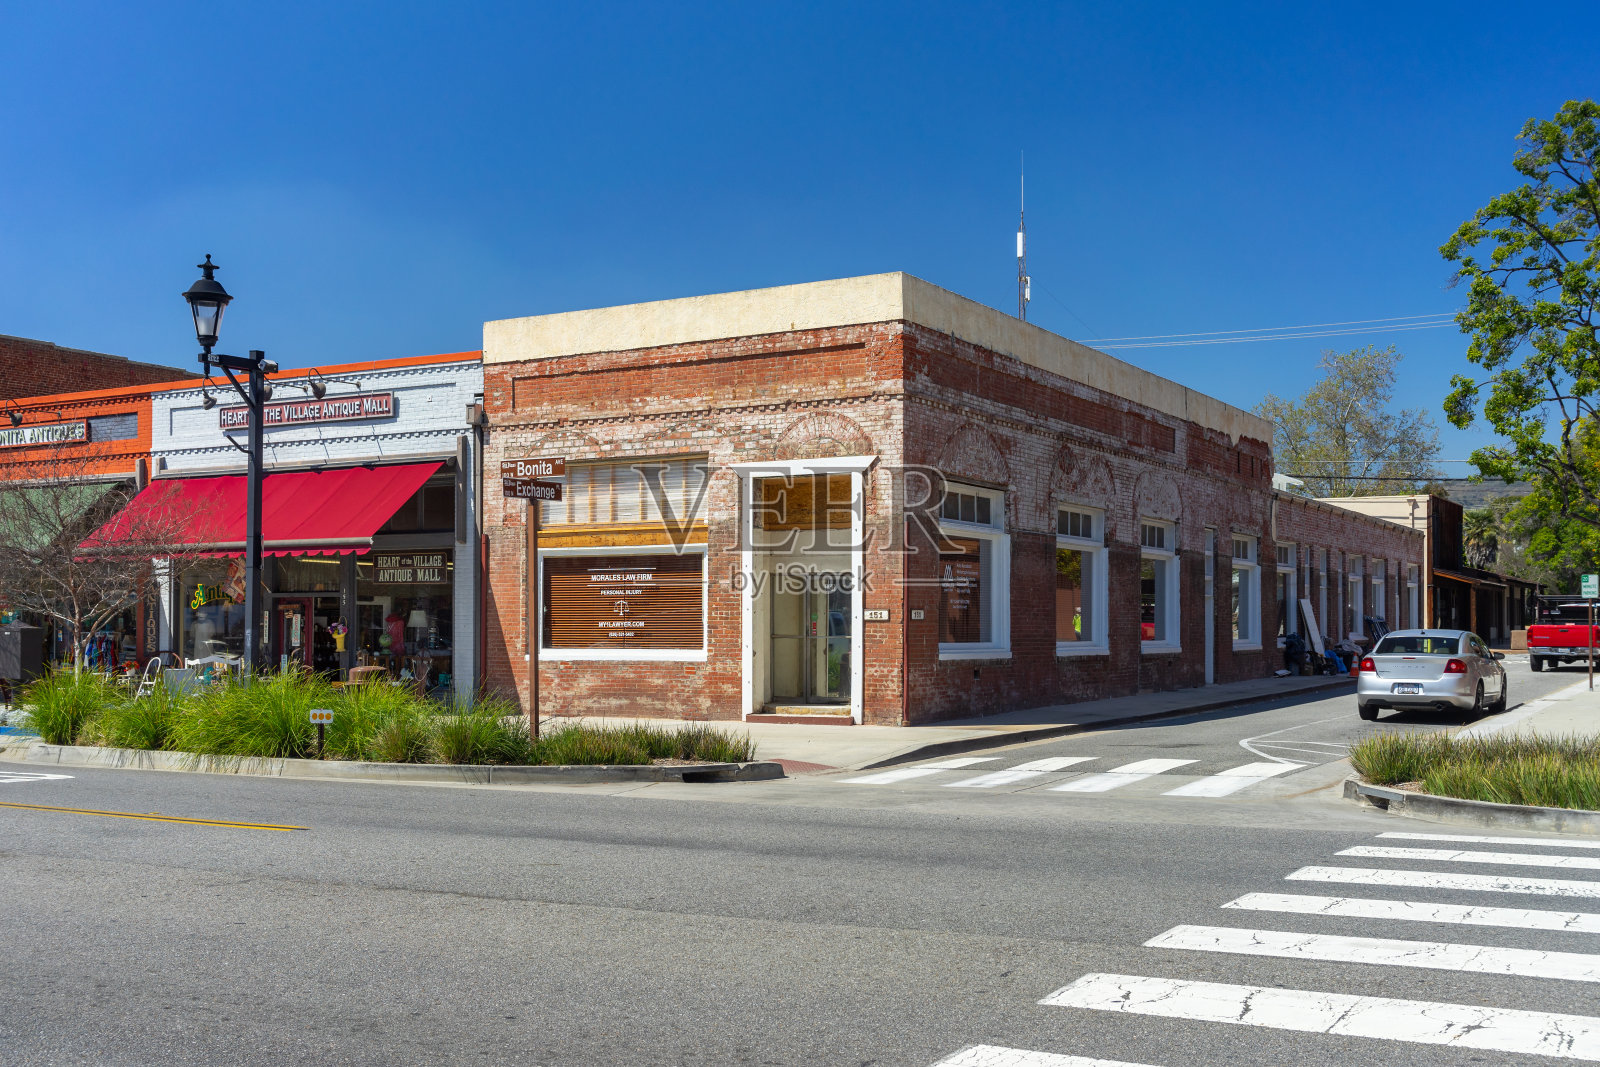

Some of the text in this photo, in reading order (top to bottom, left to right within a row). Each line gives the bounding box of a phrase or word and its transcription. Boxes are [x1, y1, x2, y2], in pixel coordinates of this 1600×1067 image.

[221, 398, 390, 426] HEART THE VILLAGE ANTIQUE MALL
[0, 423, 86, 446] NITA ANTIQUES
[517, 461, 553, 477] Bonita
[516, 481, 556, 499] Exchange
[377, 556, 400, 568] HEART
[413, 555, 442, 567] VILLAGE
[378, 568, 441, 582] ANTIQUE MALL
[591, 574, 621, 582] MORALES
[636, 573, 653, 581] FIRM
[869, 611, 884, 619] 151
